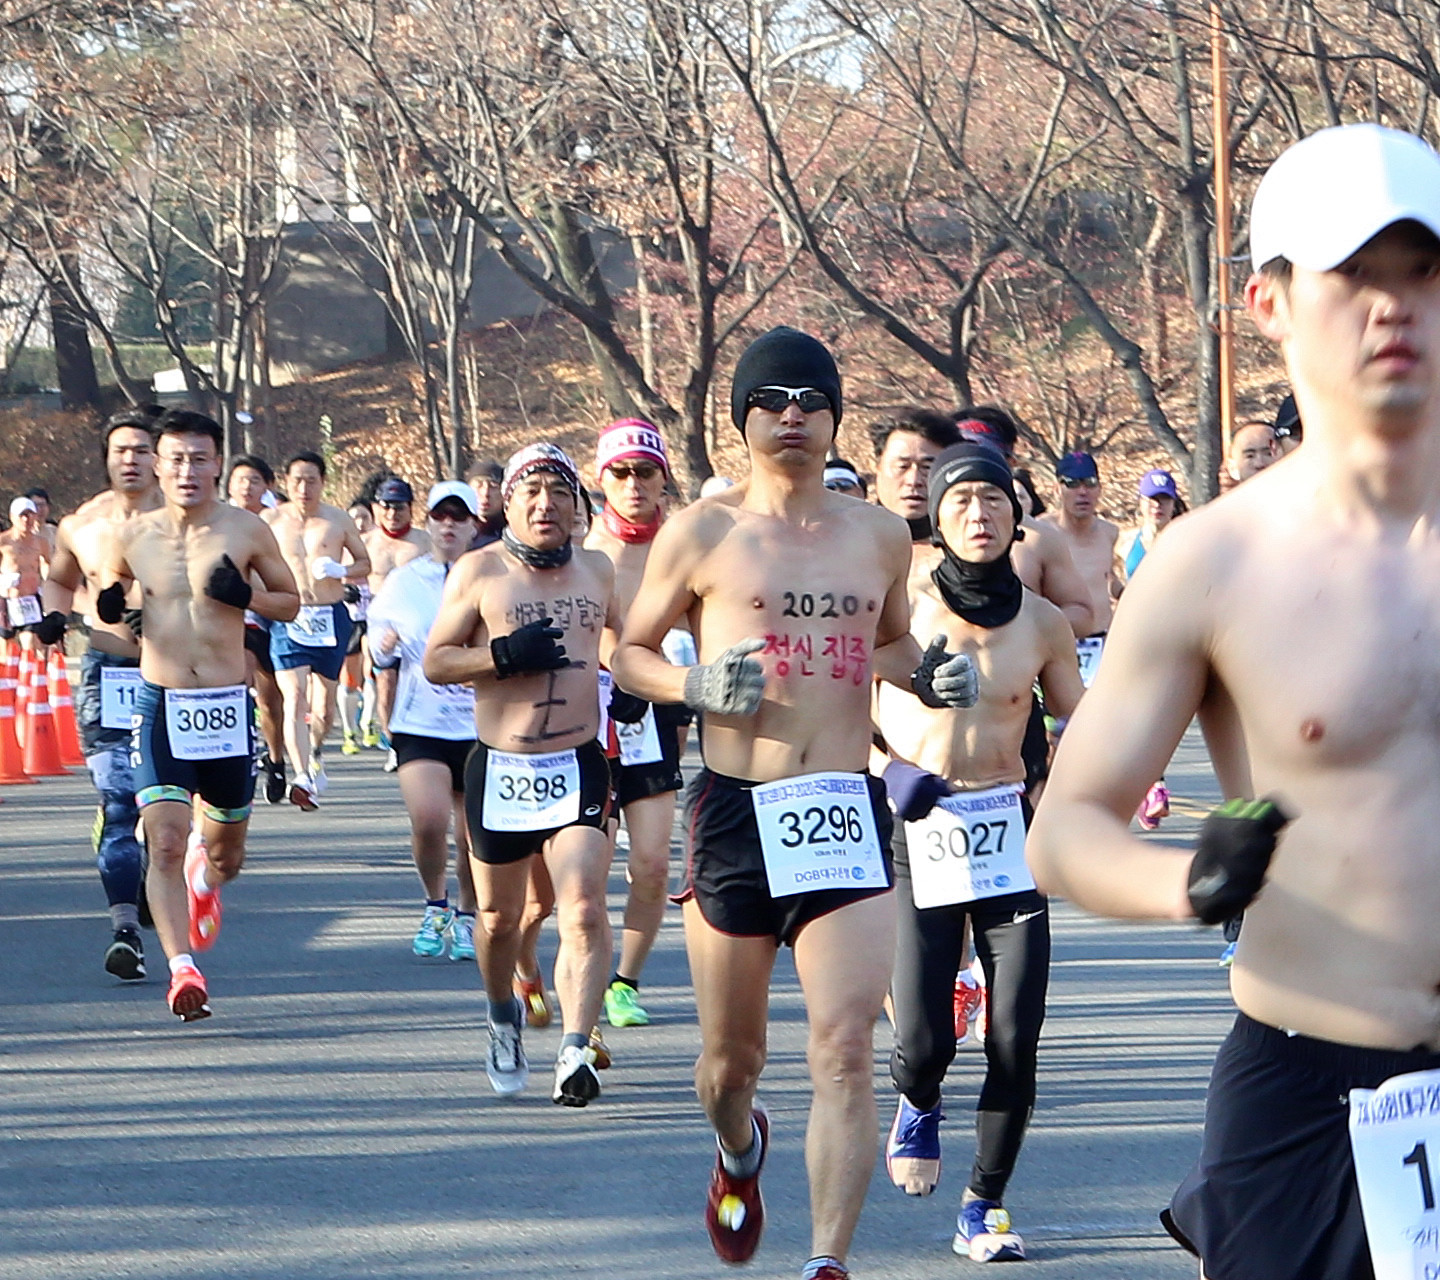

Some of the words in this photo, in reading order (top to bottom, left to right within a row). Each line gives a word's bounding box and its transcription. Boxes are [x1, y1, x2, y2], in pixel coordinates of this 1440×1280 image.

[782, 591, 859, 618] 2020
[762, 633, 814, 677] 정신
[821, 634, 867, 686] 집중
[177, 706, 237, 732] 3088
[499, 774, 568, 802] 3298
[779, 805, 863, 848] 3296
[927, 820, 1008, 861] 3027
